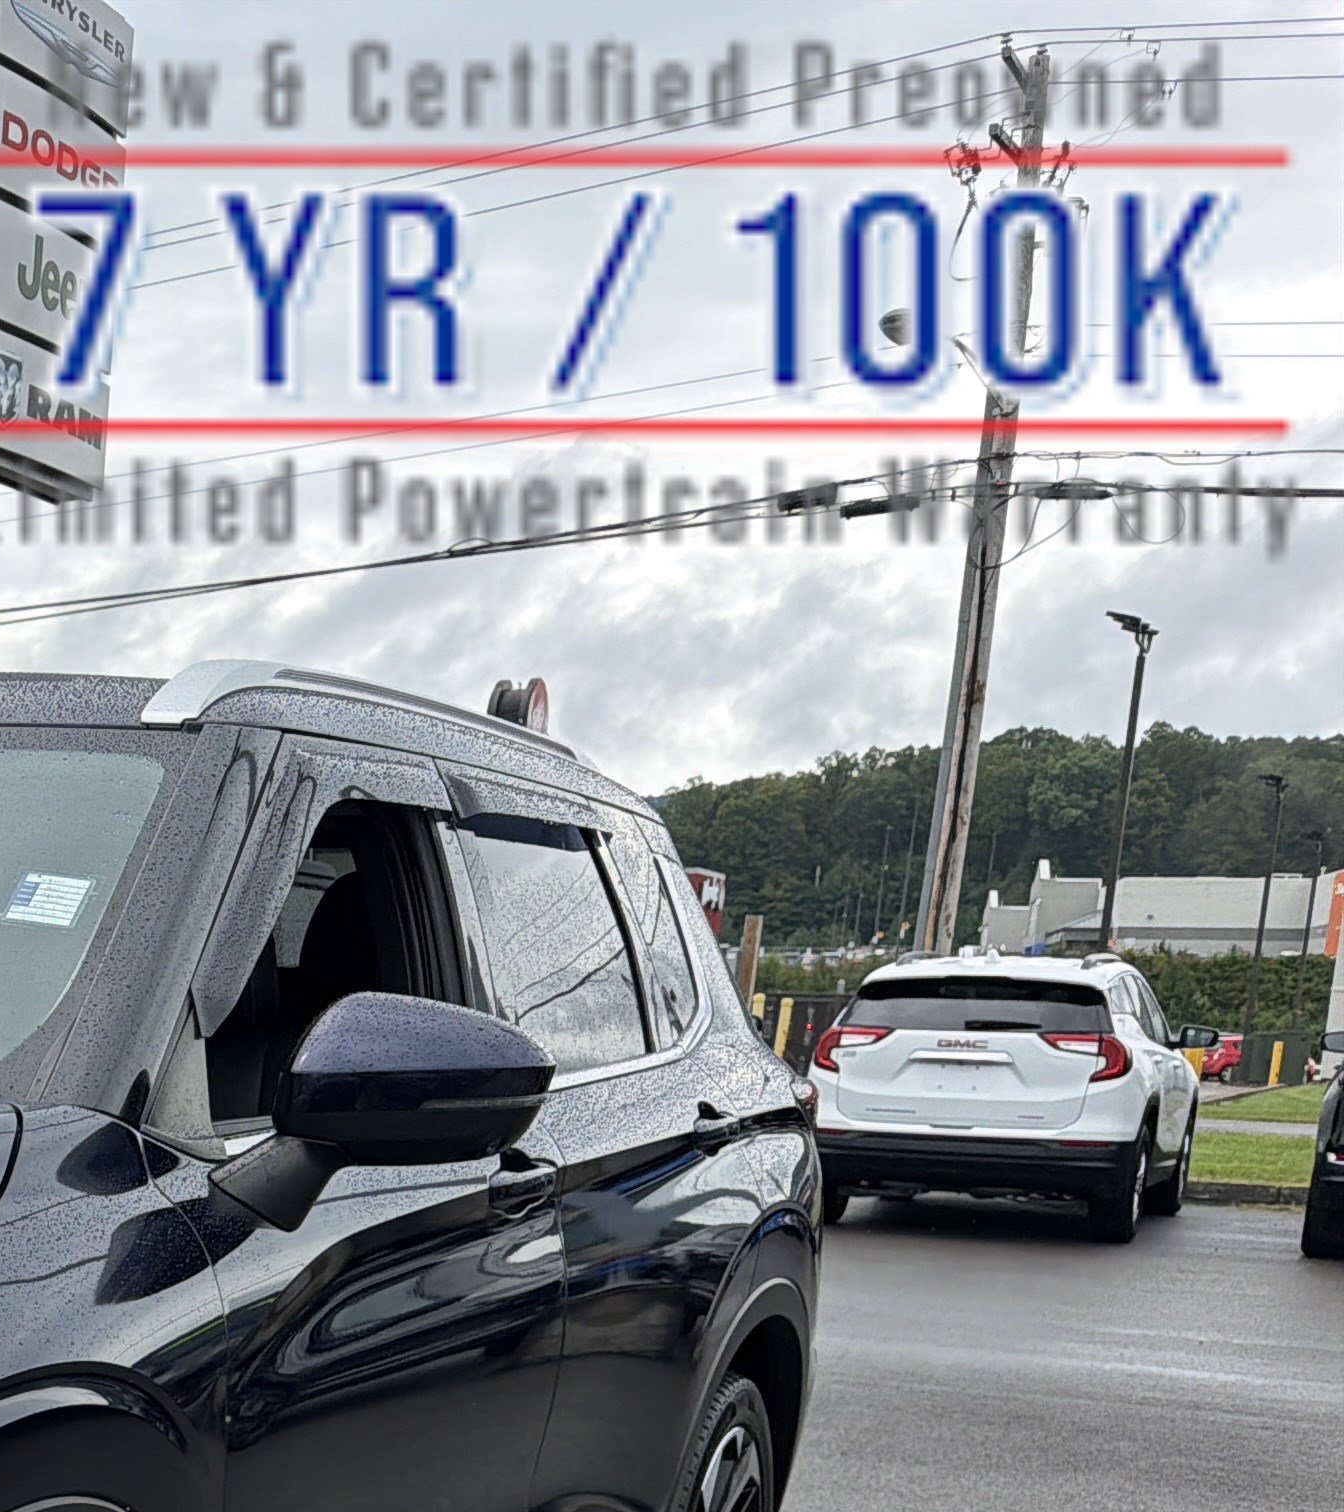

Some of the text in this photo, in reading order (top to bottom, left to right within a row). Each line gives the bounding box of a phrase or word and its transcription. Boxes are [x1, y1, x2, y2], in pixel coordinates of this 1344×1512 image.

[43, 0, 124, 62] RYSLER
[17, 234, 80, 322] Jee
[26, 384, 103, 451] RAM
[937, 1039, 989, 1049] GMC
